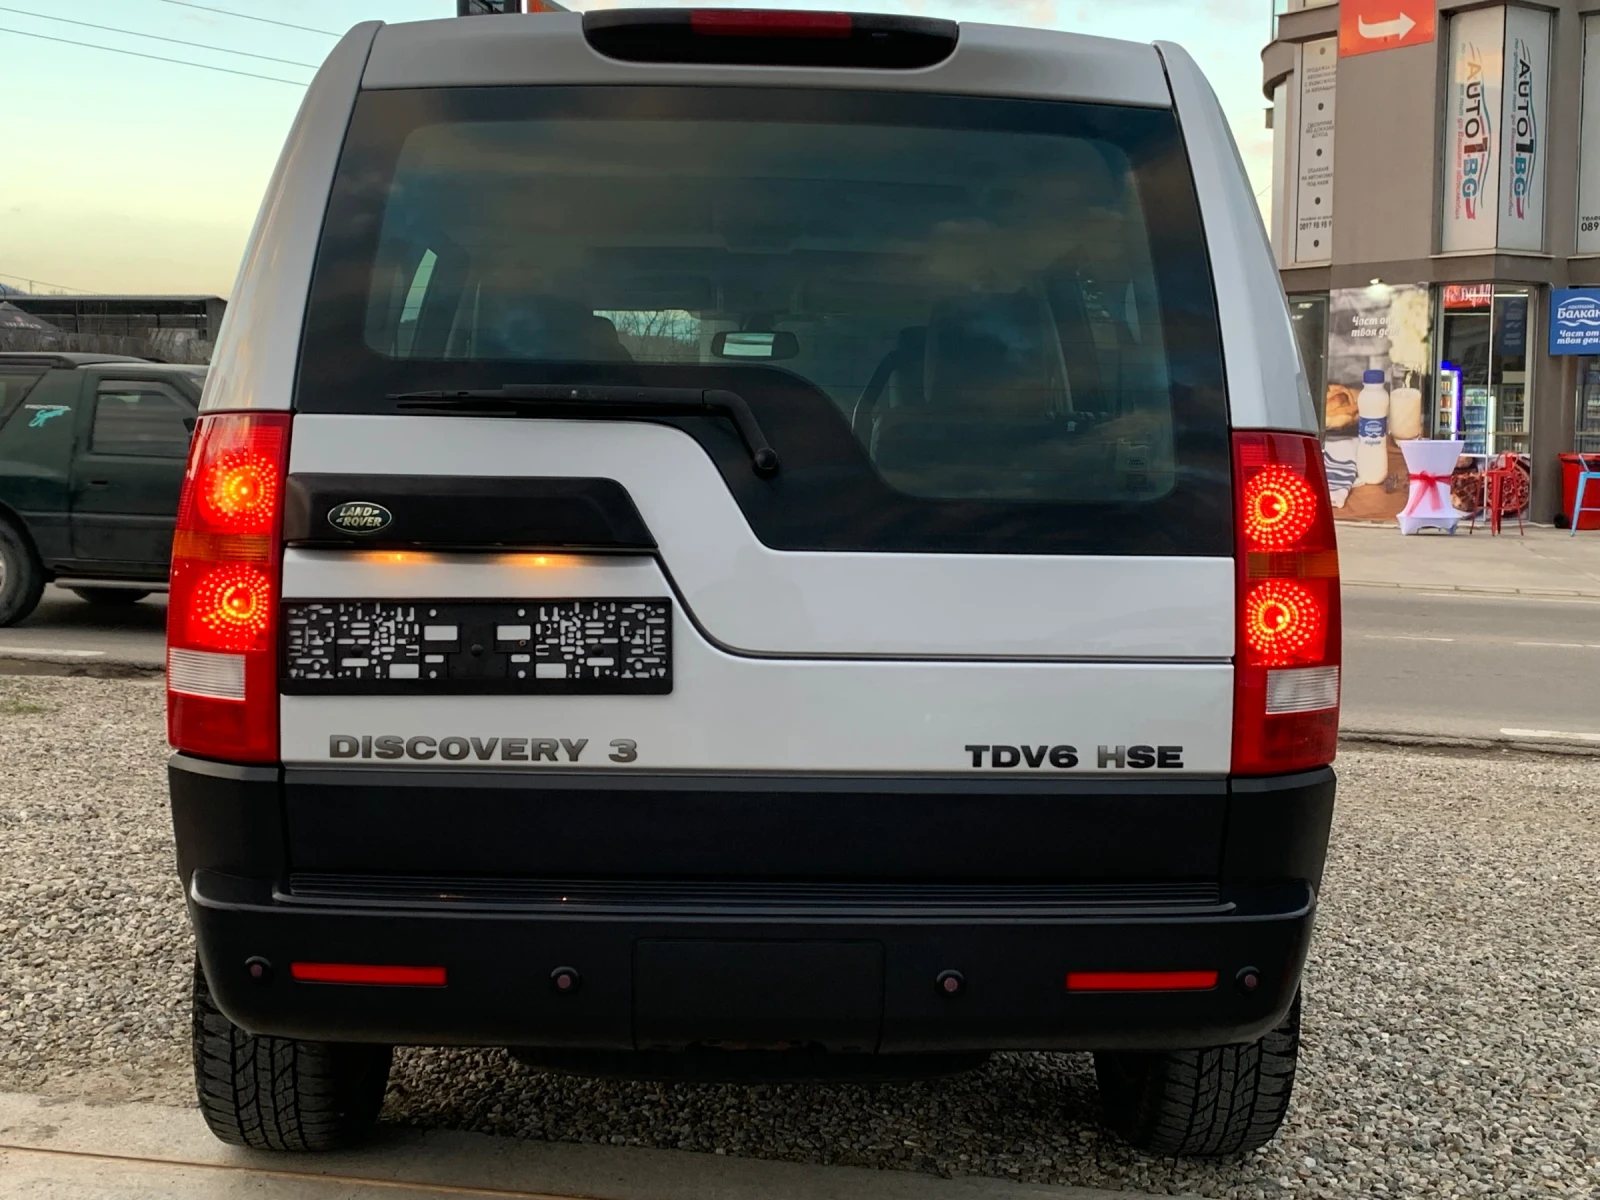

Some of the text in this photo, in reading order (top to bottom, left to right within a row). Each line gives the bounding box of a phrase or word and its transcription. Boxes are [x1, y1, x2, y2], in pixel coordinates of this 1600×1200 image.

[1352, 316, 1378, 326] Част
[1351, 327, 1377, 337] твоя
[1560, 330, 1584, 338] Част
[329, 735, 638, 763] DISCOVERY 3
[964, 745, 1184, 769] TDV6 HSE
